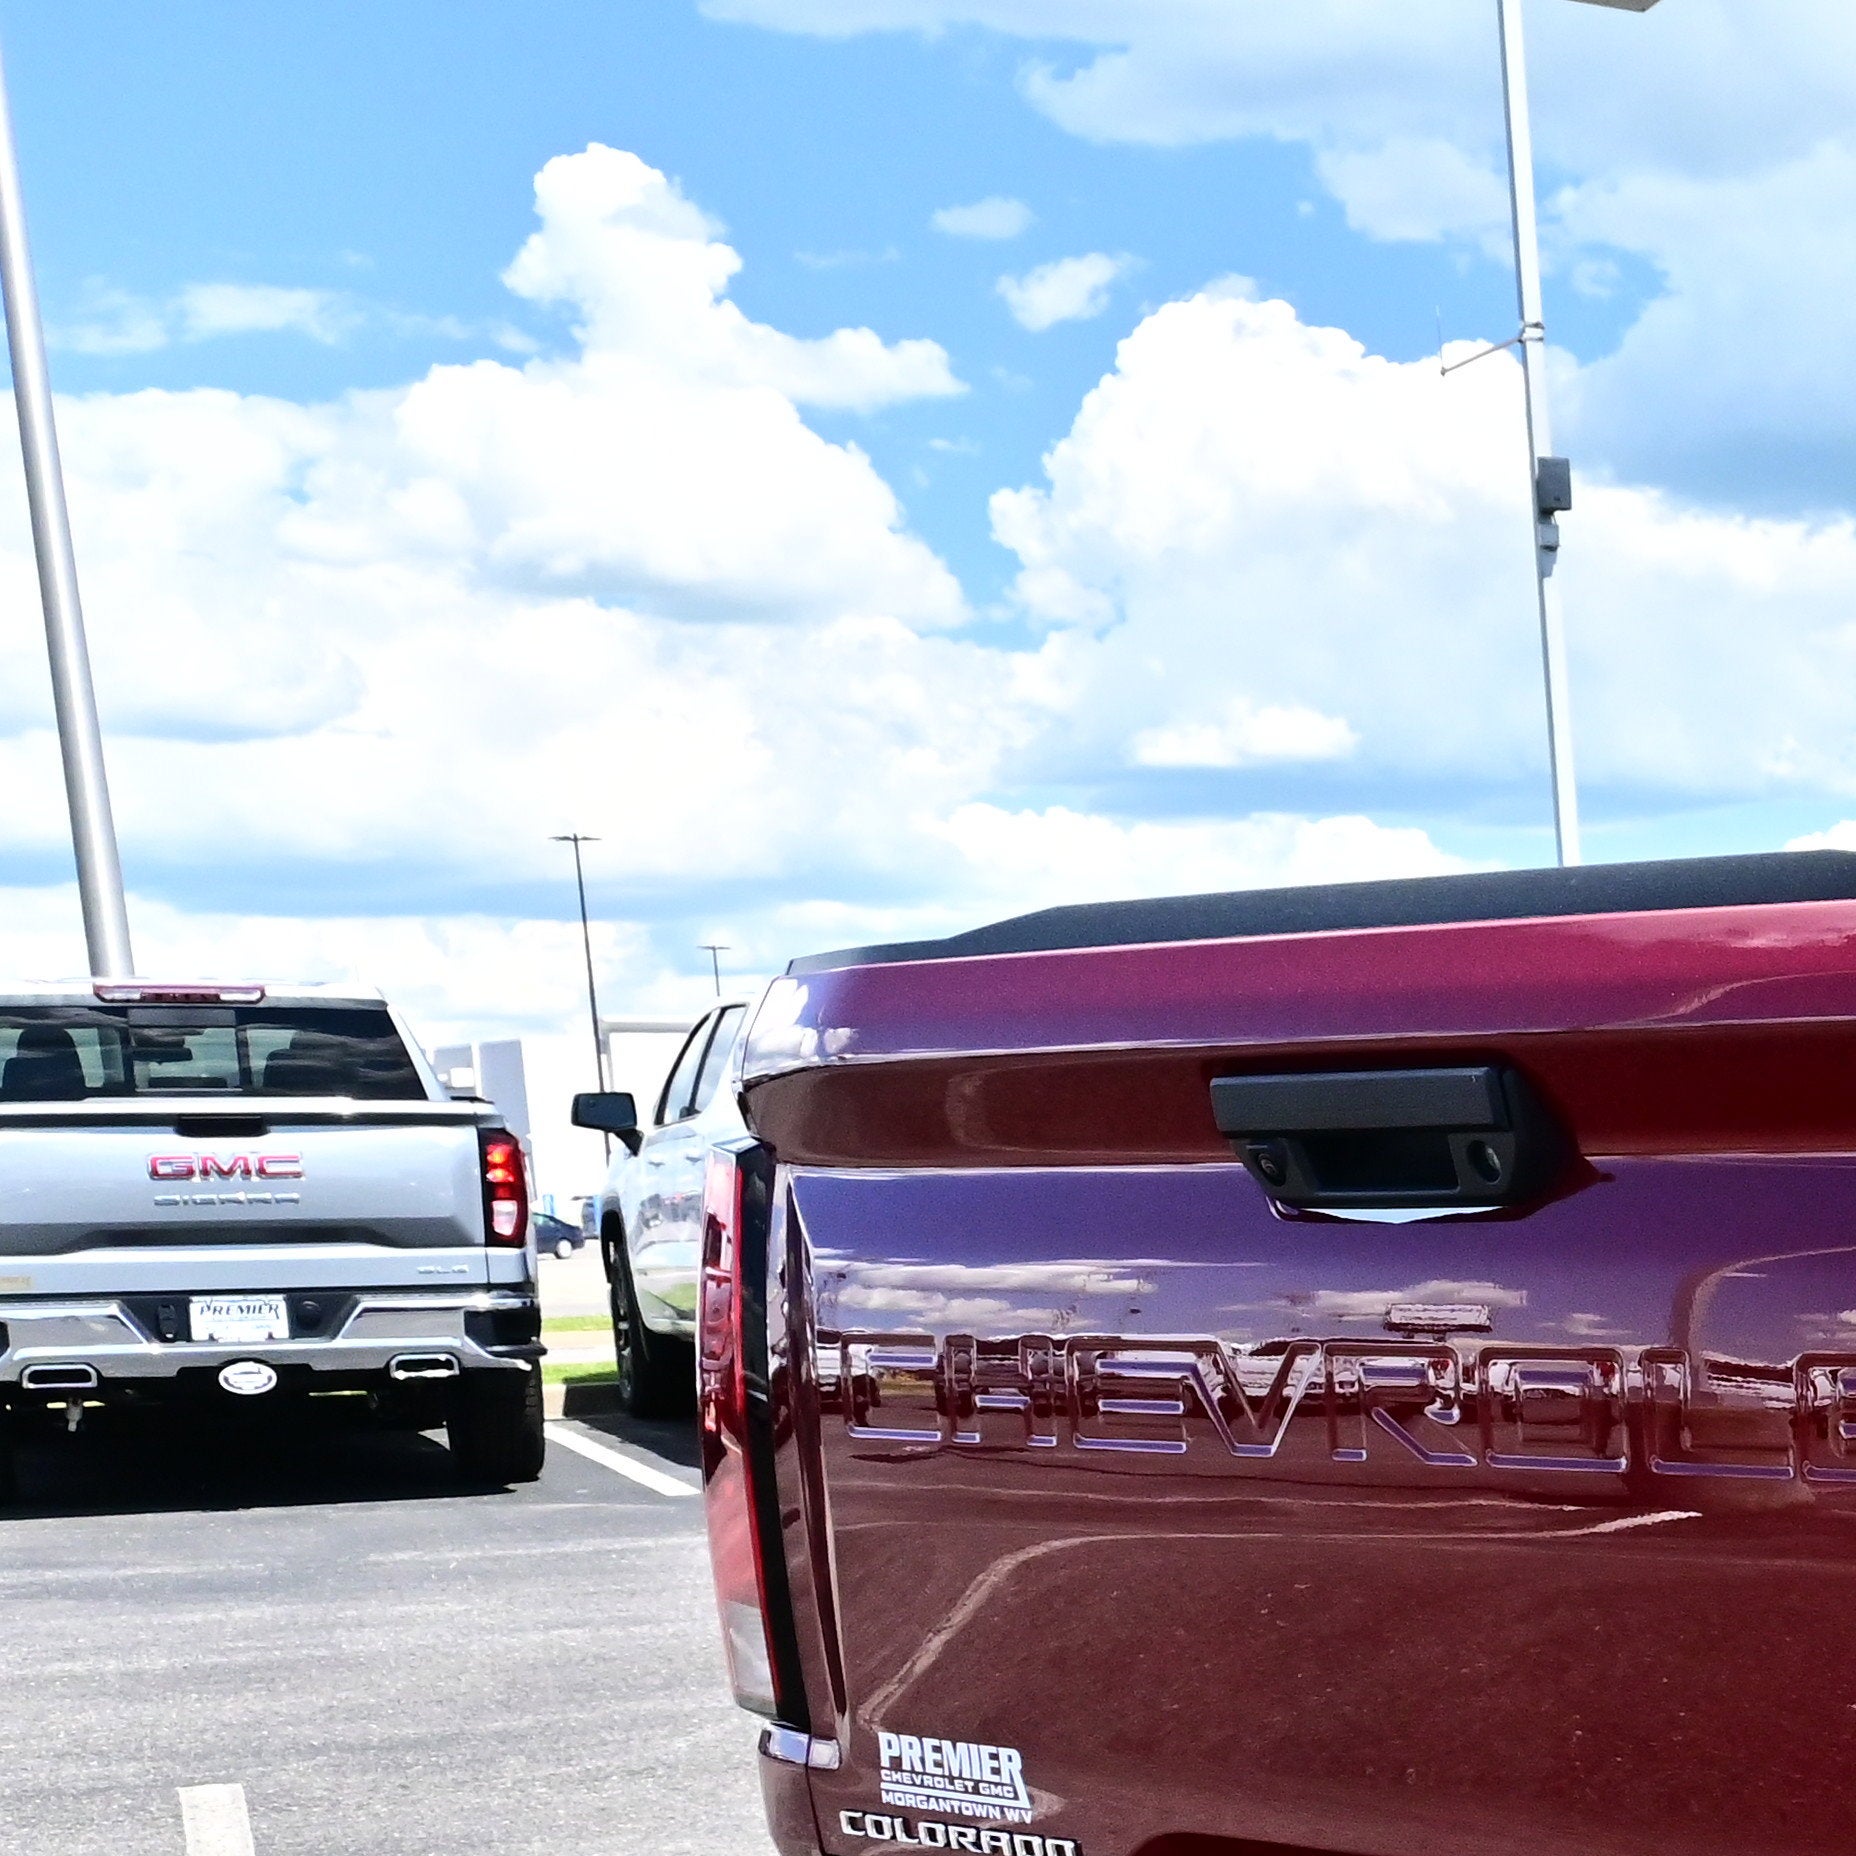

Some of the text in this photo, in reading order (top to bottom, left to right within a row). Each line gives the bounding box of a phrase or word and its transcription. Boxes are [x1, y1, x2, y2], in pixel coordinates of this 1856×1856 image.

[149, 1154, 303, 1181] GMC
[154, 1192, 300, 1206] SIERRA
[878, 1732, 1026, 1787] PREMIER
[880, 1770, 1015, 1799] CHEVROLET GMC
[881, 1790, 1032, 1824] MORGANTOWN WV
